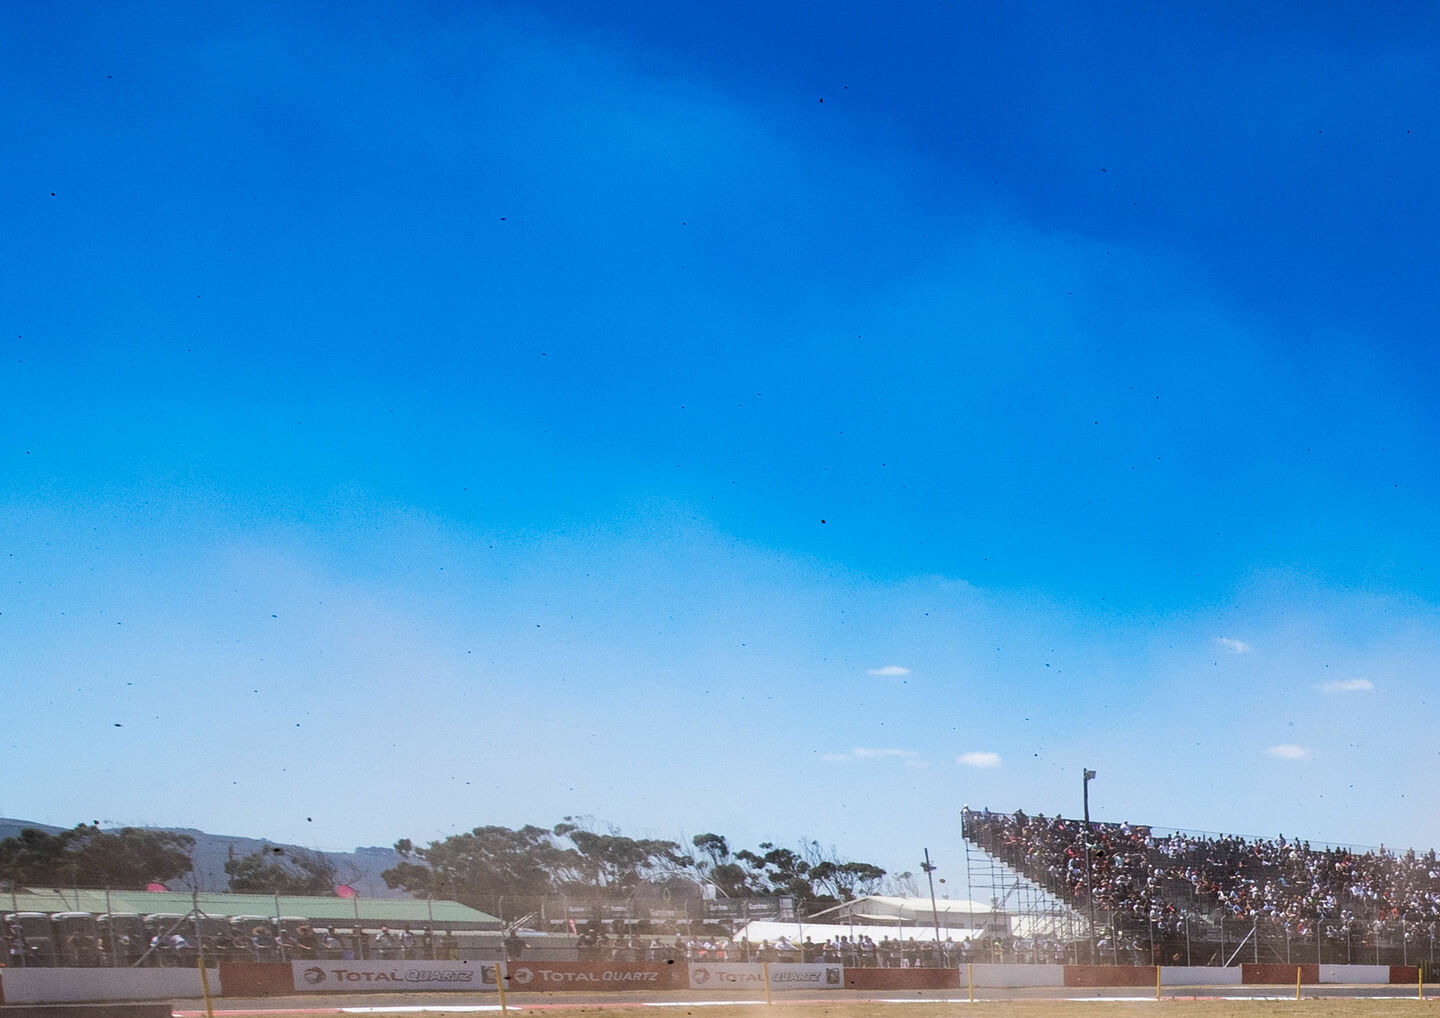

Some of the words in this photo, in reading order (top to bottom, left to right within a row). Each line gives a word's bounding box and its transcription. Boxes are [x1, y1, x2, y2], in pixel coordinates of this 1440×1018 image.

[331, 969, 405, 982] TOTAL
[404, 968, 474, 983] QUARTZ
[537, 969, 600, 982] TOTAL
[601, 970, 657, 982] QUARTZ
[771, 971, 821, 983] QUARTZ
